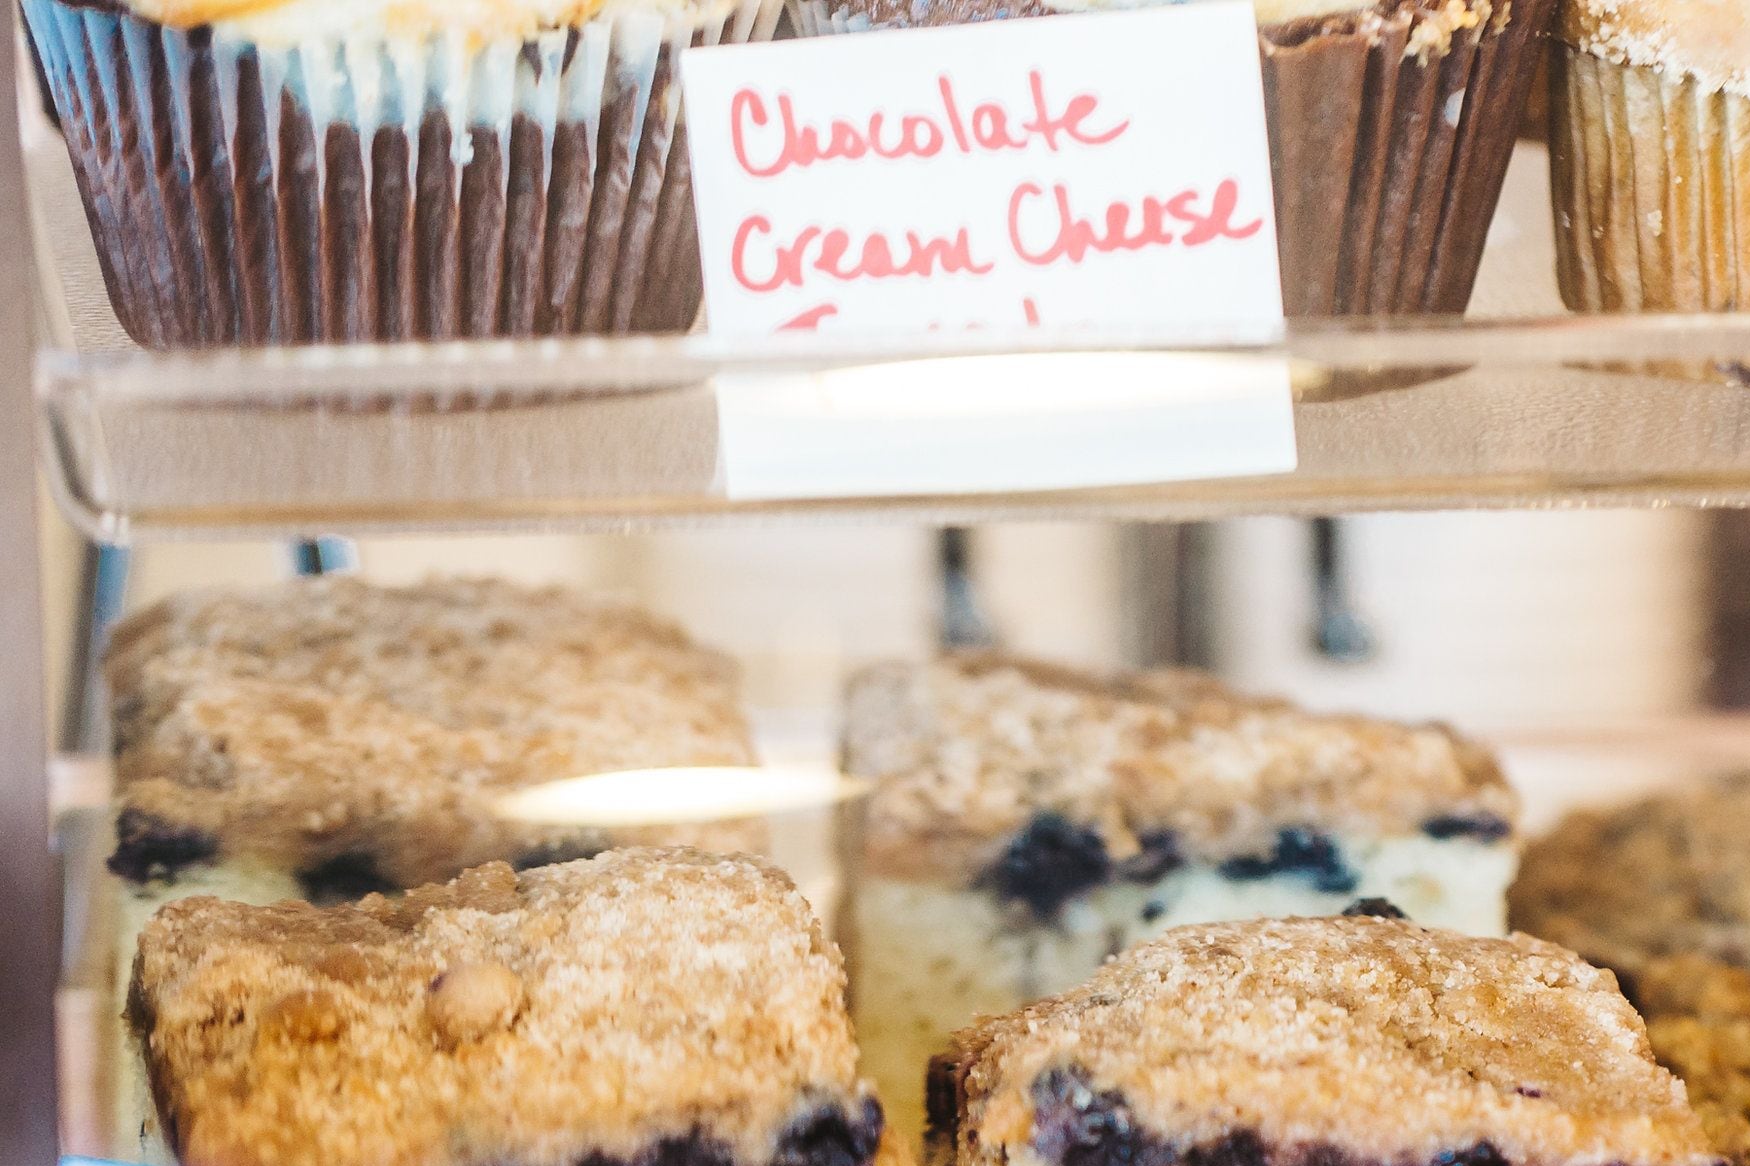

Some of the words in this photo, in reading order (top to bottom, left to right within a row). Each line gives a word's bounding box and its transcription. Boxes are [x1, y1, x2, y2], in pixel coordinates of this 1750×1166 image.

[731, 71, 1130, 177] Chocolate
[731, 215, 994, 292] Cream
[1008, 179, 1263, 266] Cheese
